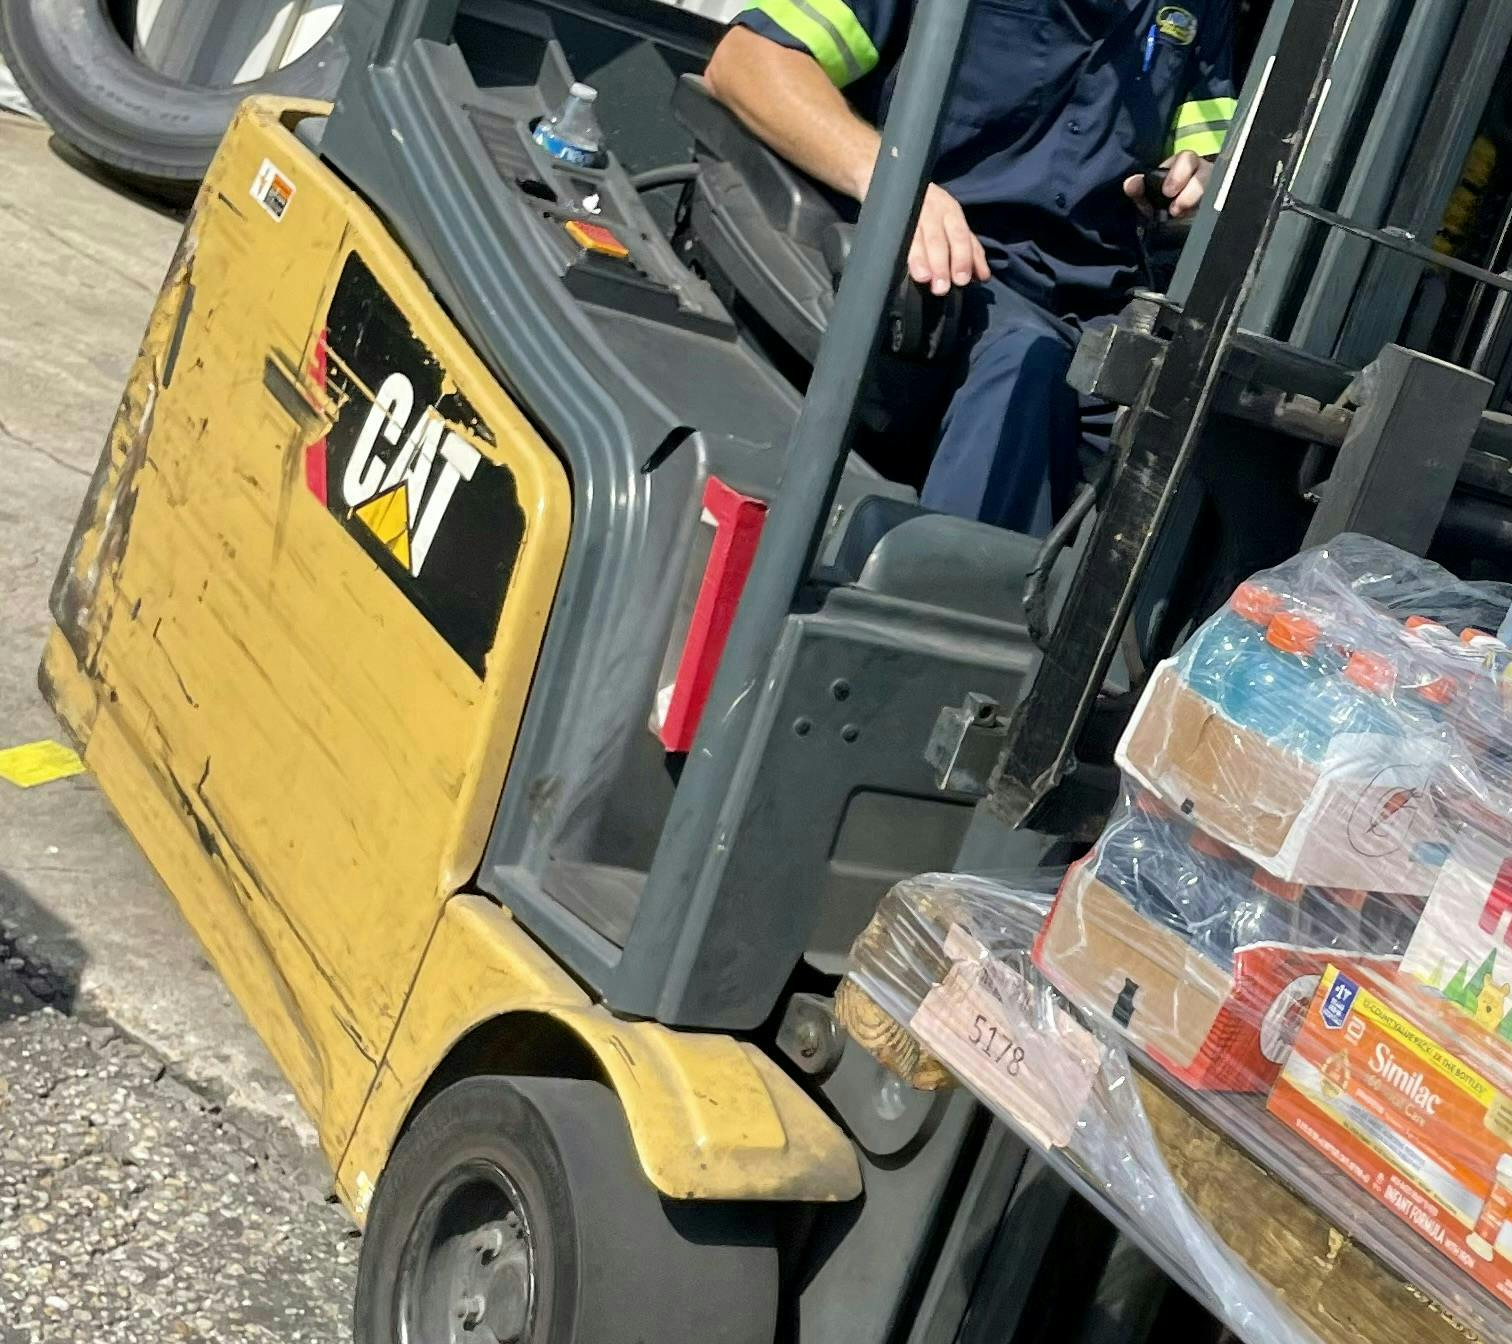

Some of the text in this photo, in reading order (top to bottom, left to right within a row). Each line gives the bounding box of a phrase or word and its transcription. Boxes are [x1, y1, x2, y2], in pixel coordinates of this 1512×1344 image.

[343, 372, 482, 578] CAT
[968, 1014, 1027, 1077] 5178
[1368, 1042, 1442, 1115] Similac
